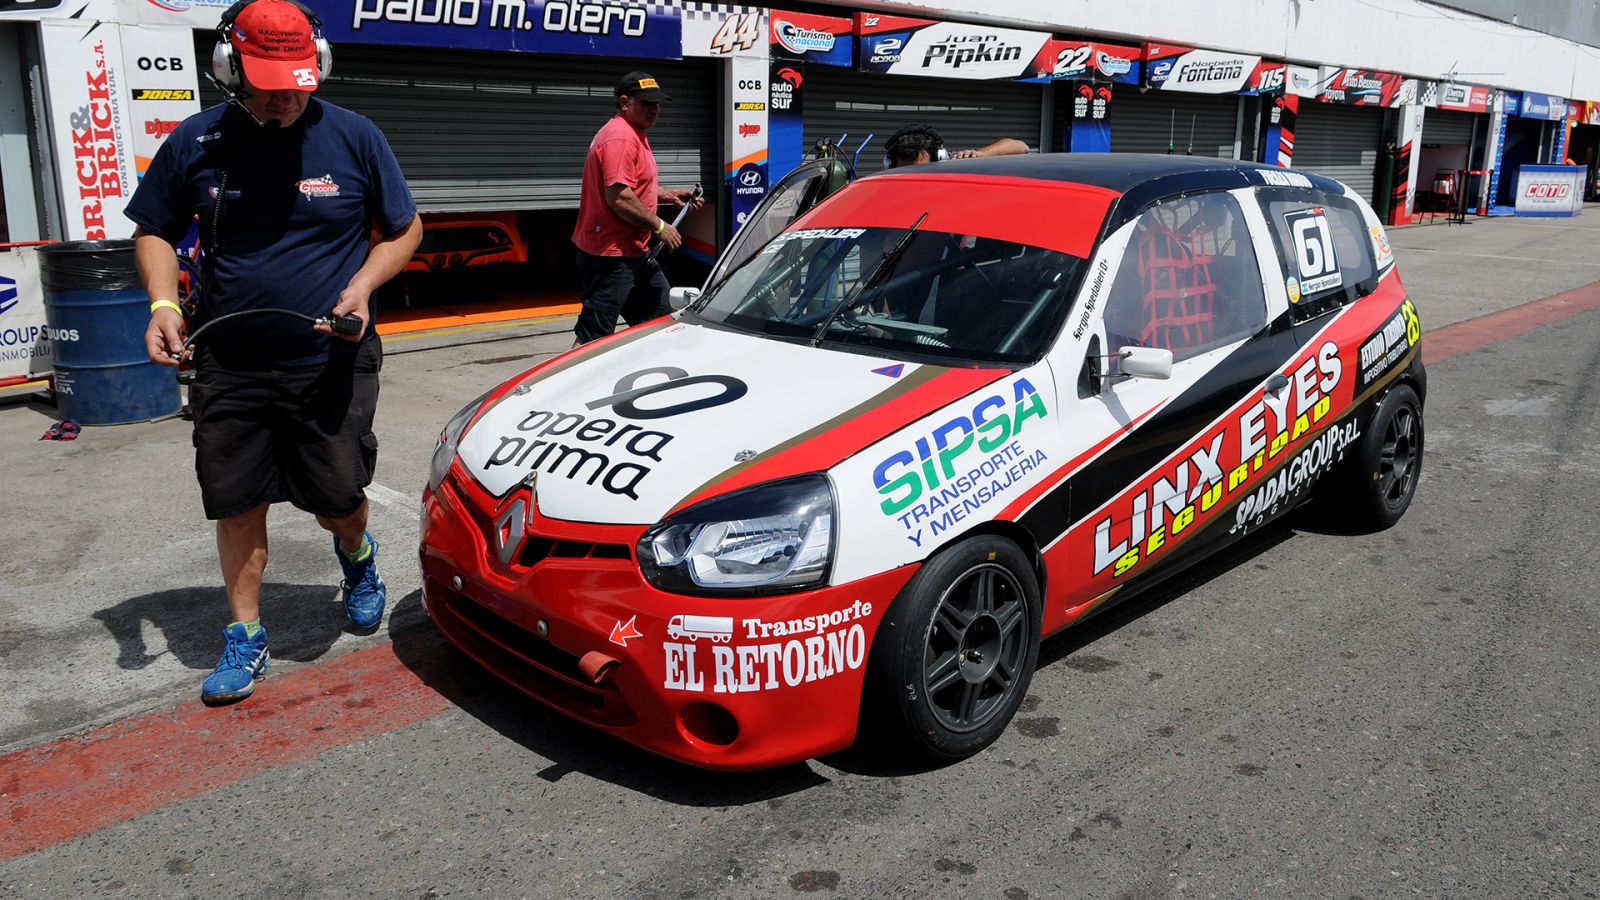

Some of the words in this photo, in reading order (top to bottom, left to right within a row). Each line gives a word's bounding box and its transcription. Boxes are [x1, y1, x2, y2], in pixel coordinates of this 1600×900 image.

[489, 0, 532, 30] m.
[543, 0, 647, 36] otero
[710, 11, 759, 54] 44
[864, 17, 880, 27] 22
[795, 37, 834, 47] nacional
[796, 29, 832, 40] Turismo
[936, 34, 997, 44] Juan
[137, 57, 183, 71] OCB
[921, 42, 1022, 71] Pipkin
[1053, 45, 1092, 74] 22
[1191, 59, 1244, 68] Norberto
[108, 67, 117, 96] VIAL
[739, 80, 761, 90] OCB
[771, 82, 792, 92] auto
[1177, 64, 1243, 83] Fontana
[1258, 66, 1286, 91] 115
[137, 90, 192, 100] JORSA
[736, 102, 764, 111] JORSA
[771, 98, 793, 109] sur
[86, 71, 122, 198] BRICK
[111, 98, 129, 197] CONSTRUCTORA
[1525, 183, 1570, 198] COTO
[1073, 311, 1090, 341] Sergio
[1085, 269, 1105, 312] Spedalieri
[516, 410, 675, 462] opera
[873, 377, 1048, 516] SIPSA
[483, 435, 651, 501] prima
[1093, 428, 1226, 576] LINX
[1239, 341, 1343, 464] EYES
[897, 440, 1024, 530] TRANSPORTE
[907, 530, 922, 547] Y
[929, 449, 1048, 536] MENSAJERIA
[1114, 395, 1331, 578] SEGURIDAD
[743, 599, 872, 639] Transporte
[663, 641, 704, 692] EL
[712, 623, 865, 694] RETORNO
